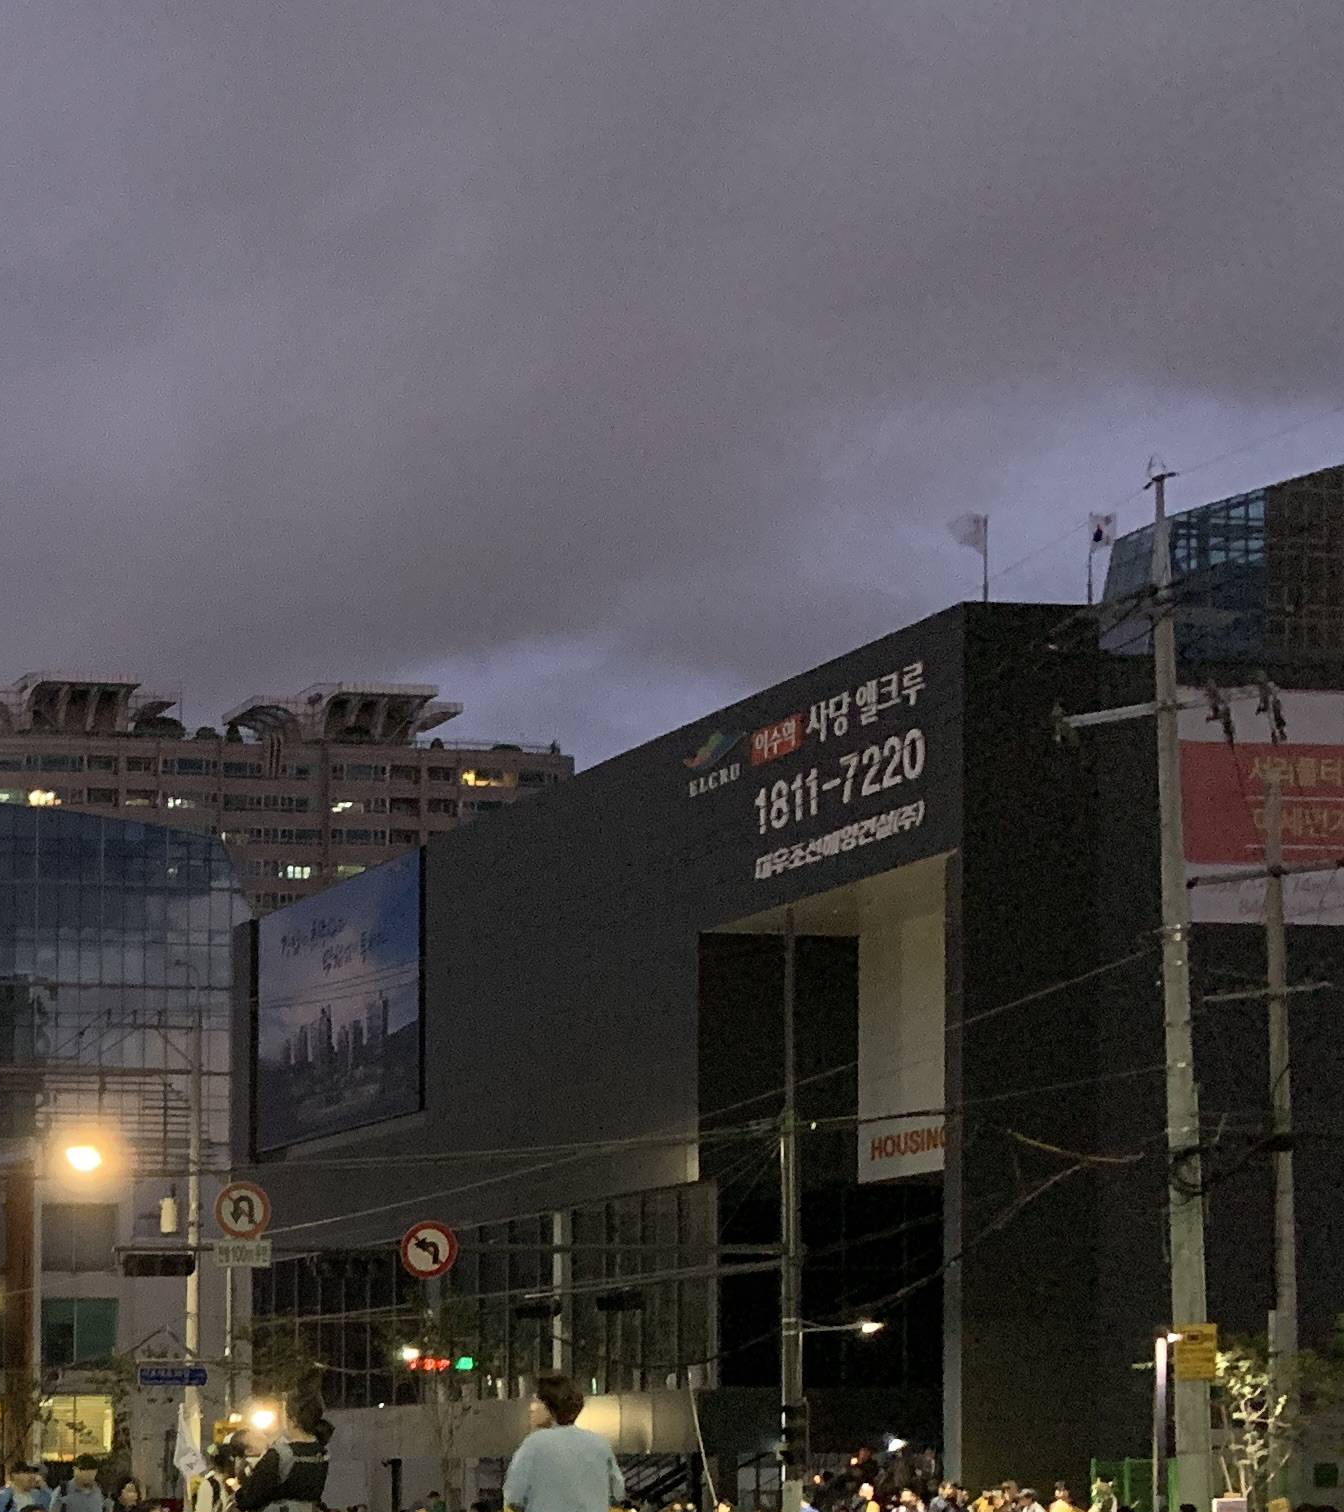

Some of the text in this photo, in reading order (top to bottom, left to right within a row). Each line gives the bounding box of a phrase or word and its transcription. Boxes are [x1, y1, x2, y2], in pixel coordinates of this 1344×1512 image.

[806, 692, 850, 742] 사당
[856, 661, 926, 725] 엘크루
[688, 763, 741, 797] ELCRU
[754, 728, 926, 835] 1811-7220
